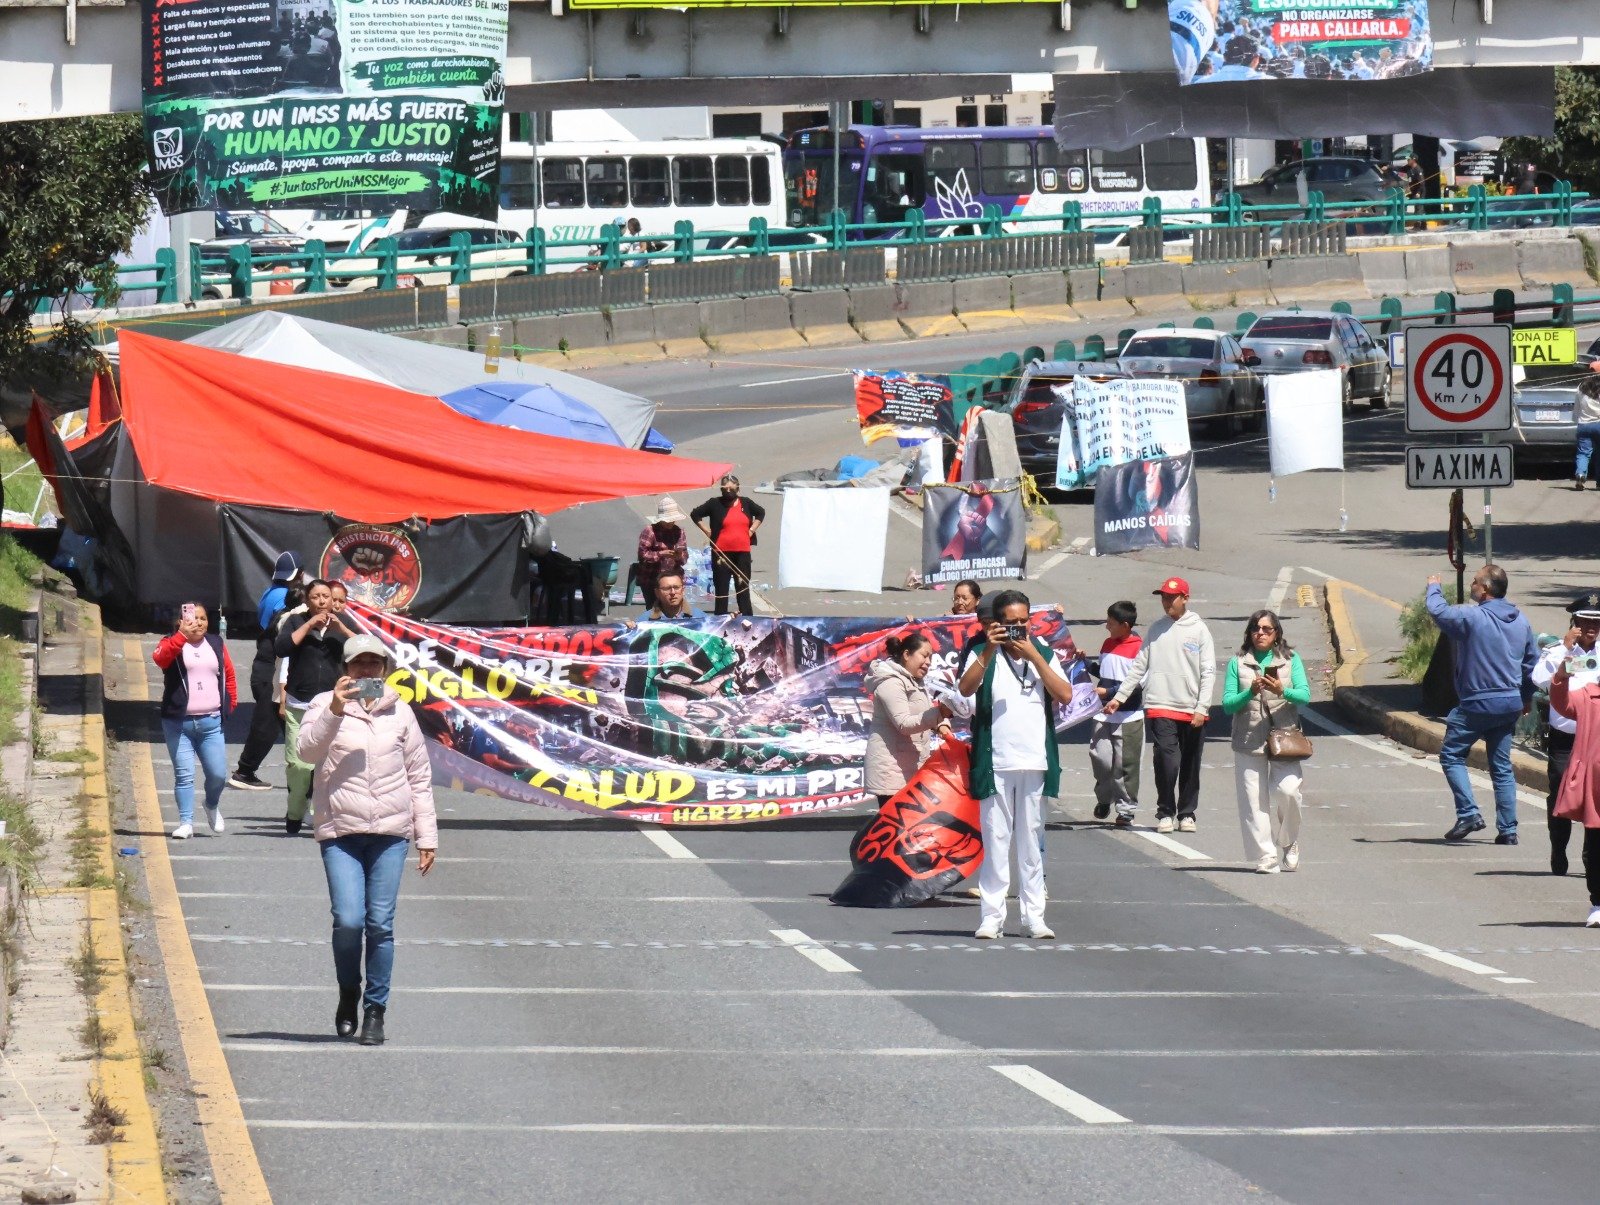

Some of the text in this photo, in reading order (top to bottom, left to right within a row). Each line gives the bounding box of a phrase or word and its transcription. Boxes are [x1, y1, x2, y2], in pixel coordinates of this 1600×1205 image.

[164, 10, 180, 18] Falta
[227, 2, 270, 12] especialistas
[475, 0, 489, 9] DEL
[492, 2, 507, 11] IMSS
[1282, 10, 1374, 20] NO ORGANIZARSE
[164, 22, 186, 31] Largas
[187, 20, 202, 28] filas
[208, 18, 236, 26] tiempos
[237, 16, 246, 24] de
[248, 16, 270, 24] espera
[1176, 10, 1208, 37] SNTSS
[1280, 20, 1403, 37] PARA CALLARLA.
[164, 36, 181, 44] Citas
[182, 34, 196, 42] que
[197, 32, 218, 40] nunca
[166, 48, 180, 56] Mala
[182, 45, 212, 54] atención
[219, 43, 236, 51] trato
[236, 40, 270, 50] inhumano
[166, 60, 200, 69] Desabasto
[212, 54, 262, 64] medicamentos
[366, 62, 380, 75] Tu
[384, 63, 403, 72] voz
[406, 60, 428, 69] como
[168, 71, 209, 82] Instalaciones
[221, 68, 241, 76] malas
[242, 66, 282, 74] condiciones
[383, 70, 436, 86] también
[204, 98, 469, 132] POR UN IMSS MÁS FUERTE,
[224, 122, 450, 156] HUMANO Y JUSTO
[155, 155, 184, 172] IMSS
[226, 150, 453, 178] ¡Súmate, apoya, comparte este mensaje!
[1544, 332, 1560, 340] DE
[1432, 349, 1484, 388] 40
[1416, 453, 1503, 480] MAXIMA
[1104, 512, 1191, 532] MANOS CAÍDAS
[333, 532, 410, 558] RESISTENCIA IMSS
[940, 556, 1006, 572] CUANDO FRACASA
[924, 574, 932, 584] EL
[962, 568, 990, 580] EMPIEZA
[992, 568, 1002, 578] LA
[801, 658, 820, 669] IMSS
[384, 667, 517, 704] SIGLO
[707, 779, 746, 800] ES
[756, 777, 796, 798] MI
[673, 802, 780, 823] HGR220
